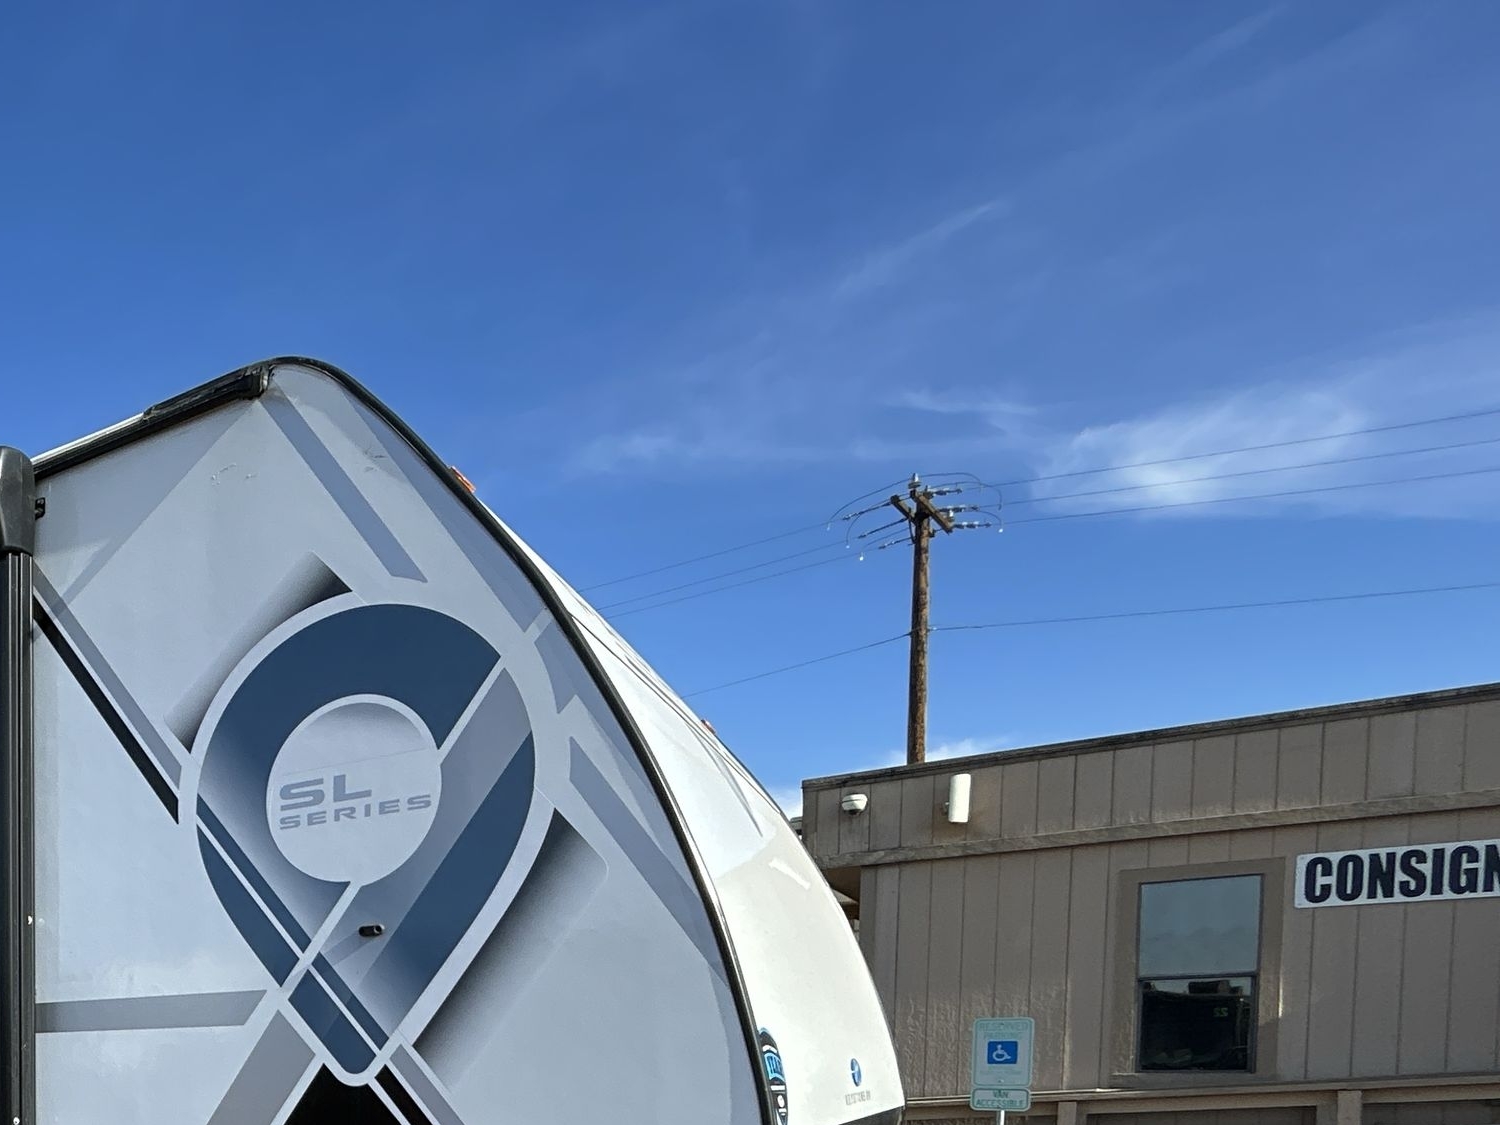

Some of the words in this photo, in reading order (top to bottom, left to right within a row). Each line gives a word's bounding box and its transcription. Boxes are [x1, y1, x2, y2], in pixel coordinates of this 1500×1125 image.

[279, 774, 372, 811] SL
[279, 794, 432, 830] SERIES
[1304, 844, 1500, 904] CONSIGN
